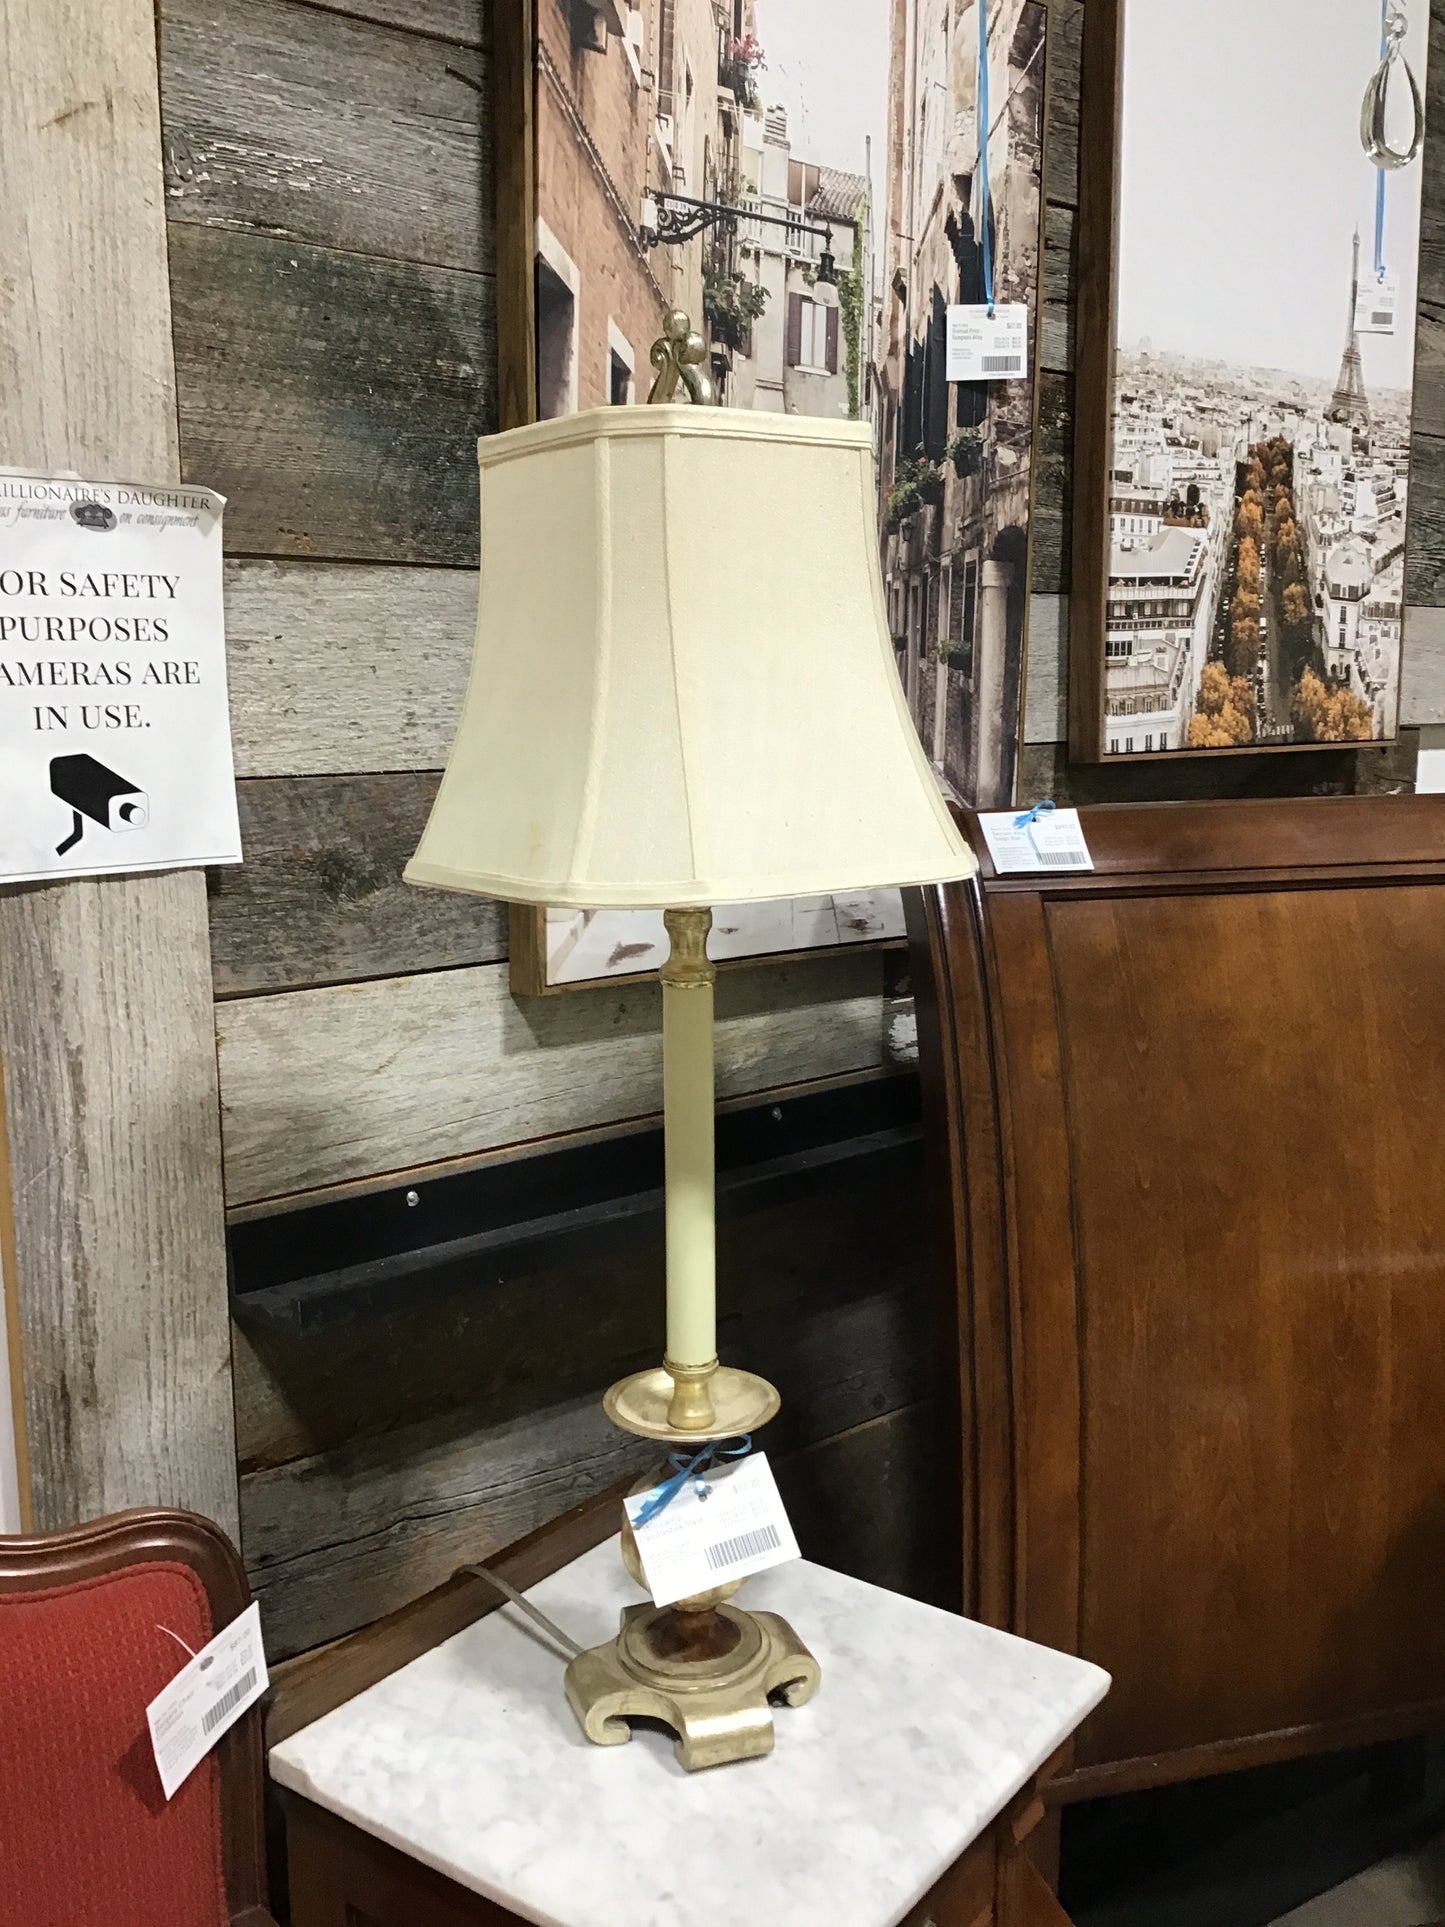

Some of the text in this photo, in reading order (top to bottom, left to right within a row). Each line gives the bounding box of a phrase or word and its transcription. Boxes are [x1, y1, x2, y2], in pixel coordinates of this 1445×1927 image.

[0, 483, 211, 510] ILLIONAIRE'S DAUGHTER
[5, 500, 67, 528] furniture
[119, 512, 132, 525] on
[136, 510, 200, 533] consignment
[60, 571, 181, 599] SAFETY
[0, 616, 169, 642] PURPOSES
[141, 661, 201, 685] ARE
[33, 704, 151, 730] IN USE.
